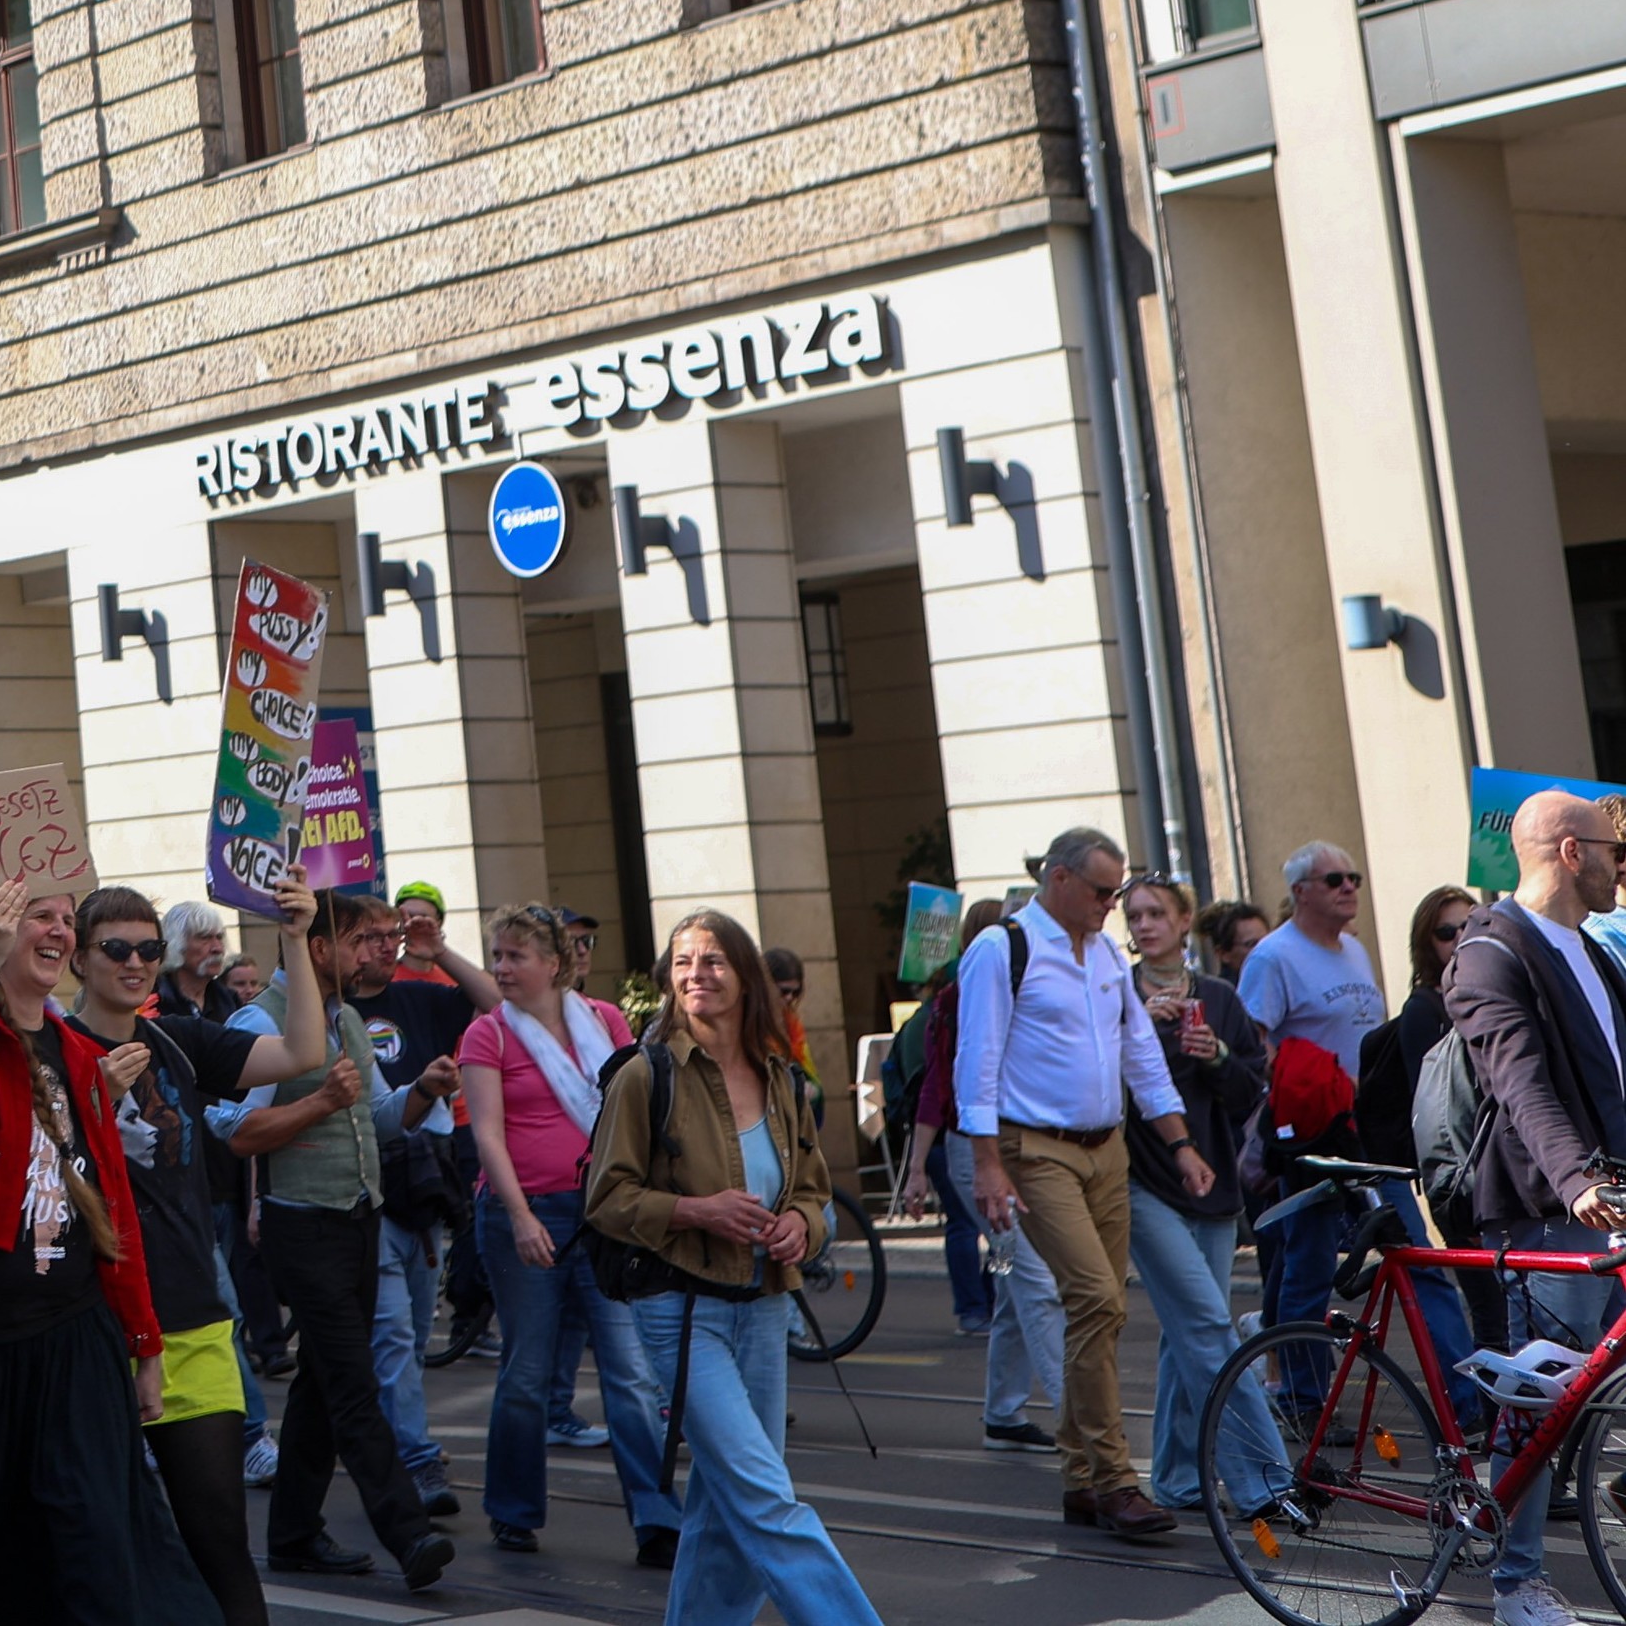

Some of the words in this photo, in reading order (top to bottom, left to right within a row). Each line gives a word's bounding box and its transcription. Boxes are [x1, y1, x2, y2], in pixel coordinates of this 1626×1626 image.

[196, 381, 491, 498] RISTORANTE
[544, 292, 884, 430] essenza
[501, 506, 559, 531] essenza
[259, 611, 324, 656] PUSSY!
[251, 689, 314, 733] CHOICE!
[256, 760, 309, 808] BODY!
[304, 785, 361, 810] emokratie.
